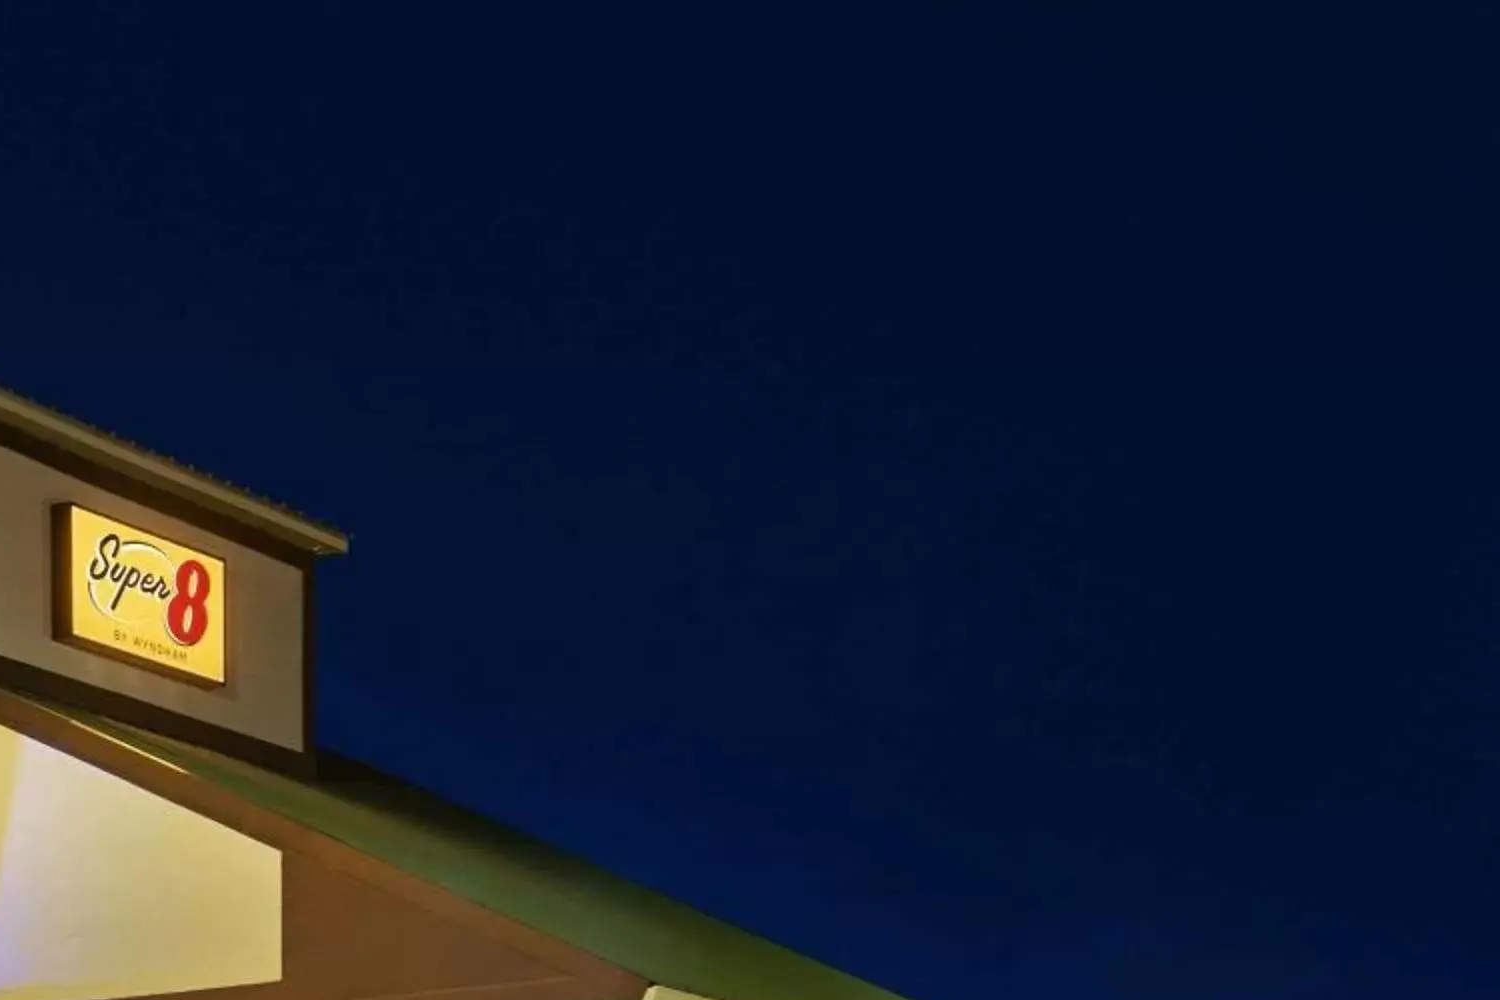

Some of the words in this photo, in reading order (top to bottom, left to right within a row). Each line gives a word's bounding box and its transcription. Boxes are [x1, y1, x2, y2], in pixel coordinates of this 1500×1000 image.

[89, 533, 171, 611] Super
[165, 559, 211, 647] 8
[113, 629, 128, 642] BY
[132, 634, 188, 662] WYNDHAM
